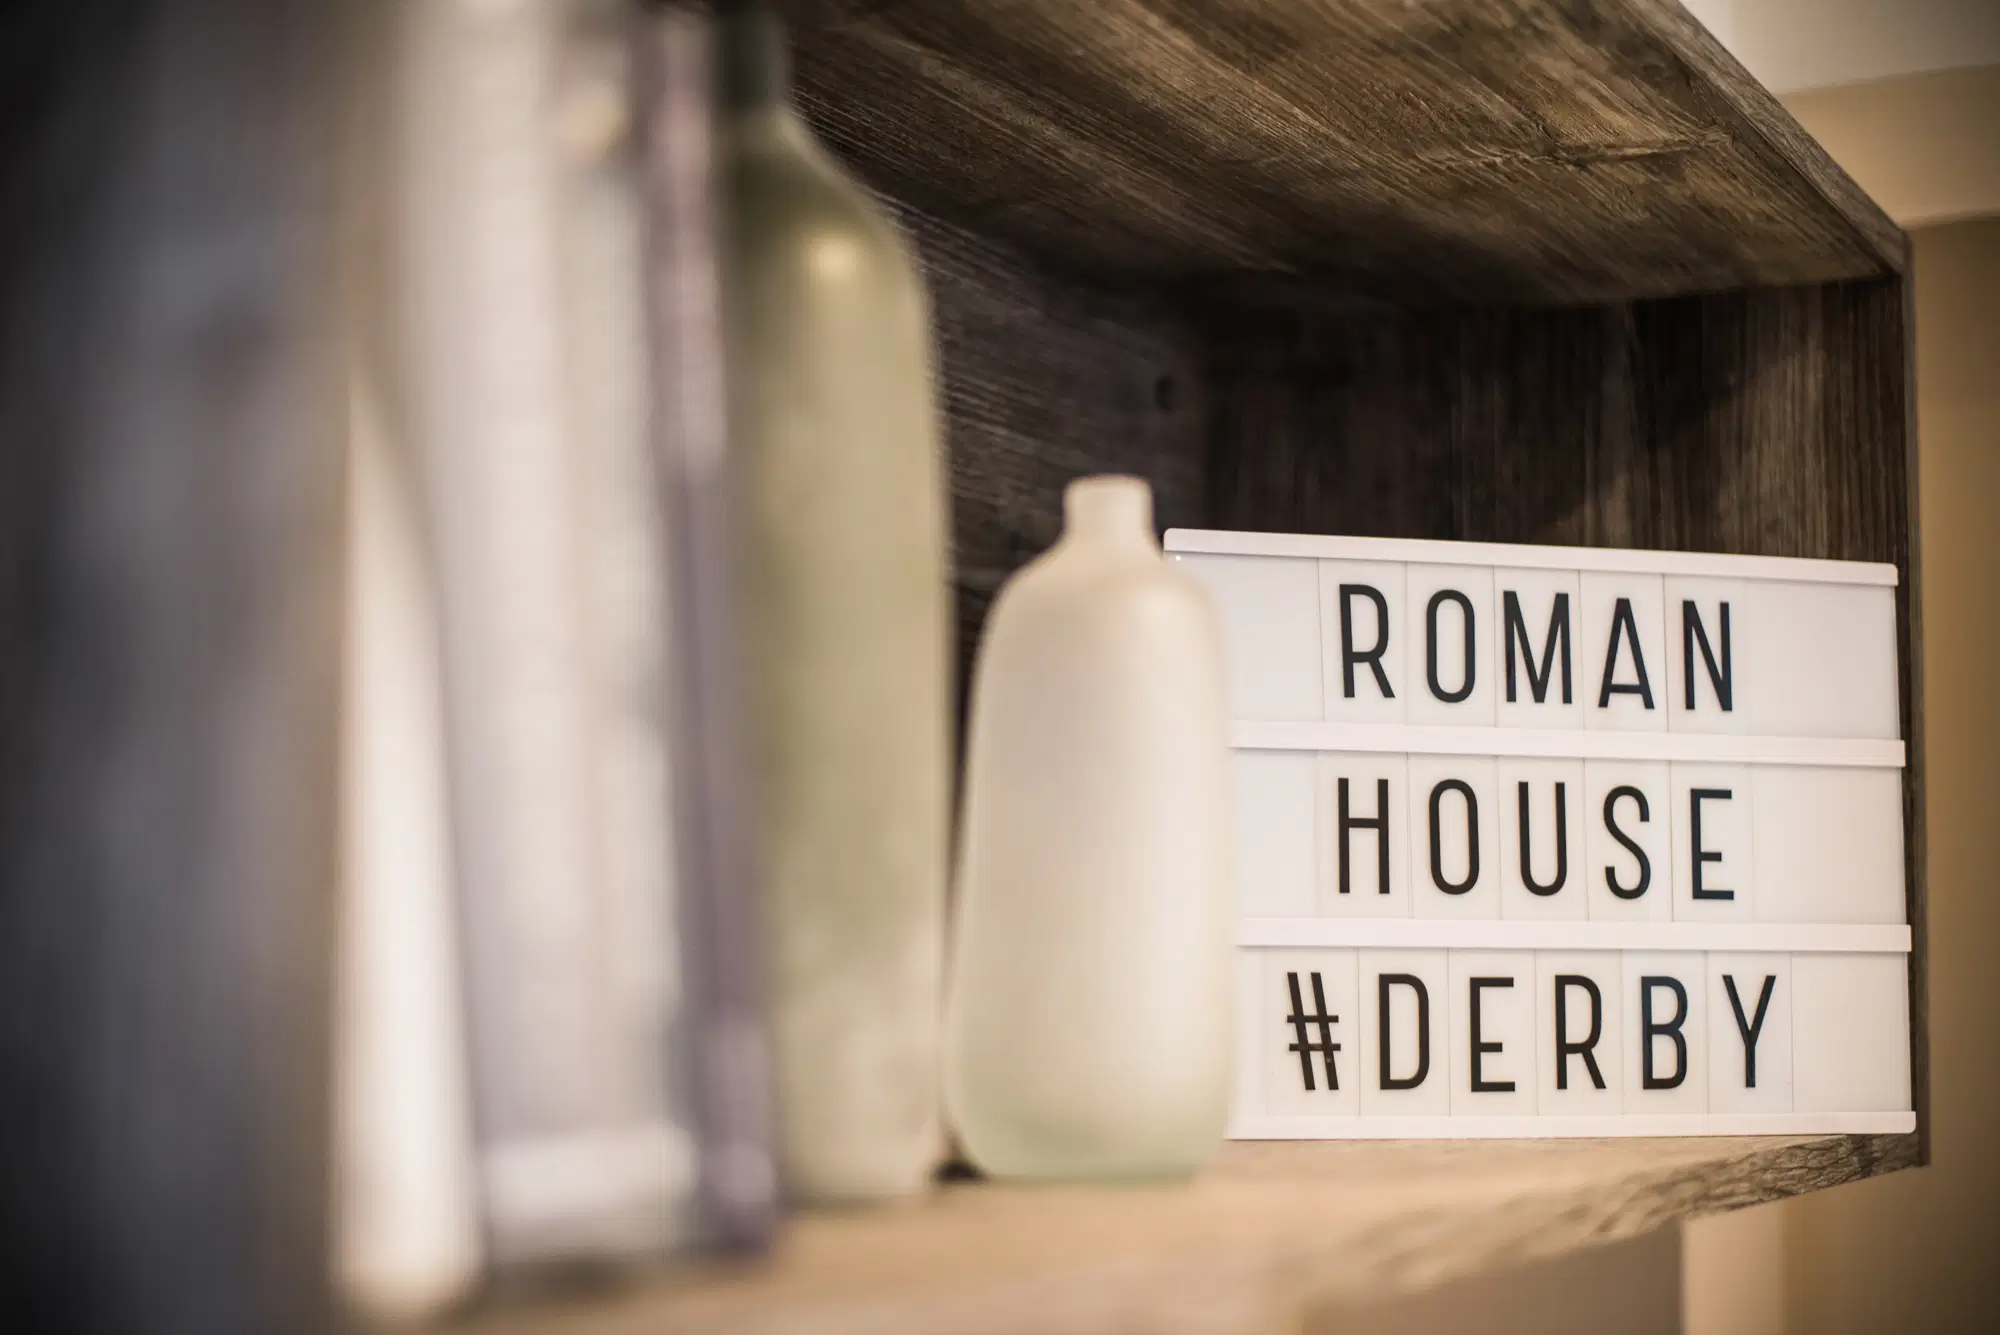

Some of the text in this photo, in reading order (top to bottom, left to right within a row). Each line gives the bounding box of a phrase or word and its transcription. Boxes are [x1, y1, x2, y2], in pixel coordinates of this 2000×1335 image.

[1338, 583, 1734, 712] ROMAN
[1337, 777, 1735, 901] HOUSE
[1286, 971, 1777, 1093] #DERBY
